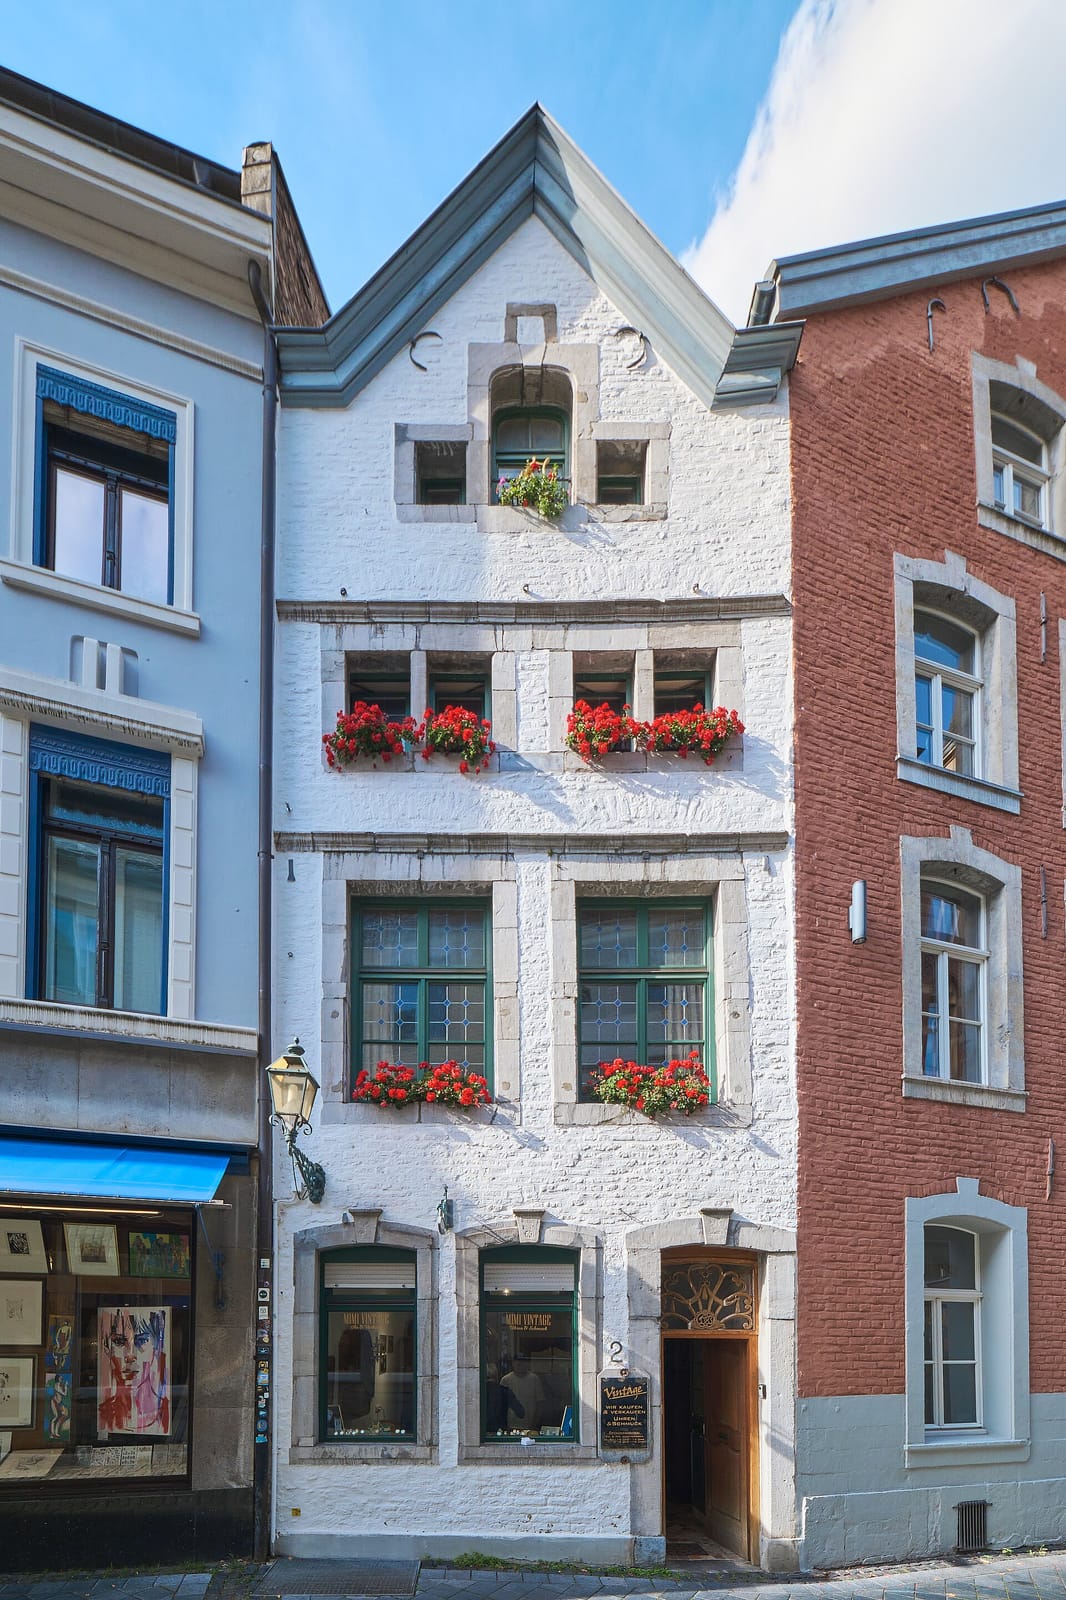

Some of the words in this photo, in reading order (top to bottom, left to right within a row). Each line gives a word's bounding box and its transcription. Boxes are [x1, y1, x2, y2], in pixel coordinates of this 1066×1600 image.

[505, 1313, 521, 1325] MIMI
[523, 1313, 551, 1326] VINTAGE
[610, 1341, 623, 1362] 2
[603, 1385, 644, 1400] Vintage
